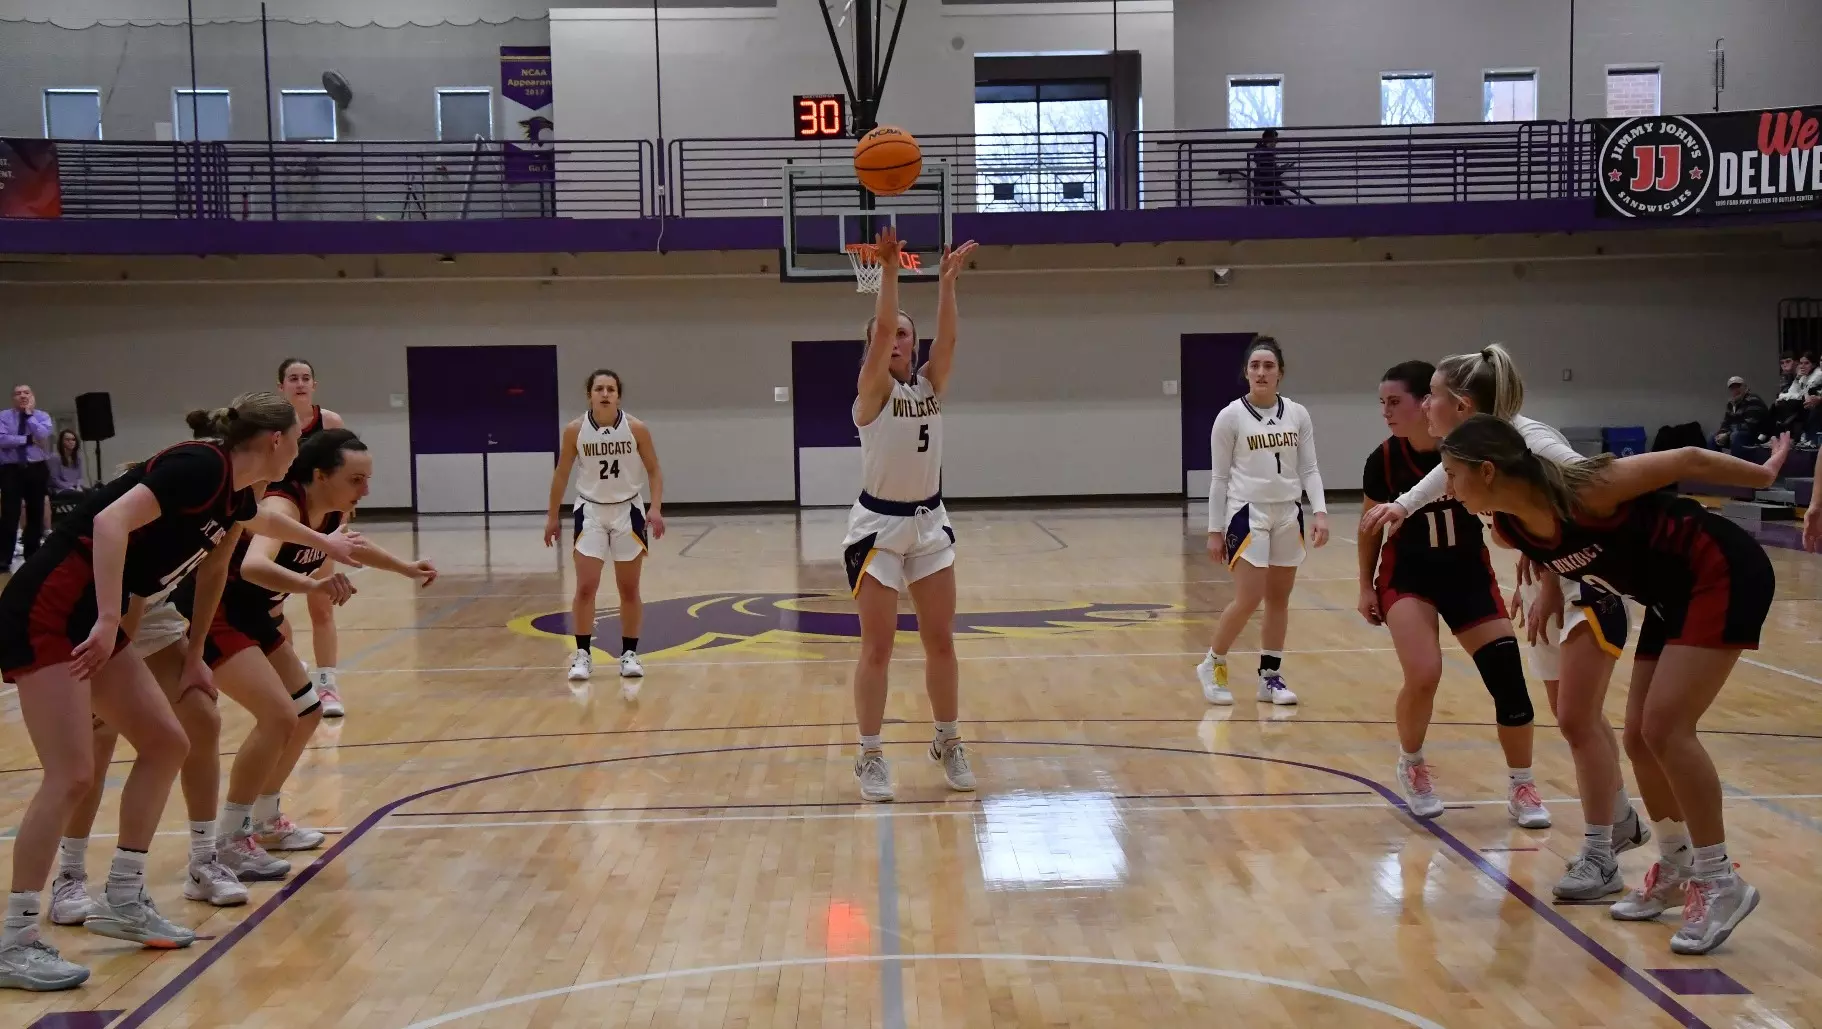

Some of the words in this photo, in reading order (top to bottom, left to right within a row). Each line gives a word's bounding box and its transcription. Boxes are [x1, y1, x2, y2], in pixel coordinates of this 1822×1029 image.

[507, 79, 552, 88] Appearan
[800, 99, 839, 135] 30
[1611, 123, 1654, 160] JIMMY
[1659, 122, 1702, 158] JOHN'S
[1758, 110, 1819, 156] We
[1630, 144, 1681, 191] JJ
[1618, 189, 1692, 212] SANDWICHES
[582, 441, 632, 456] WILDCATS
[917, 424, 929, 452] 5
[1247, 432, 1298, 450] WILDCATS
[599, 459, 620, 480] 24
[1275, 452, 1281, 474] 1
[1424, 508, 1456, 547] 11
